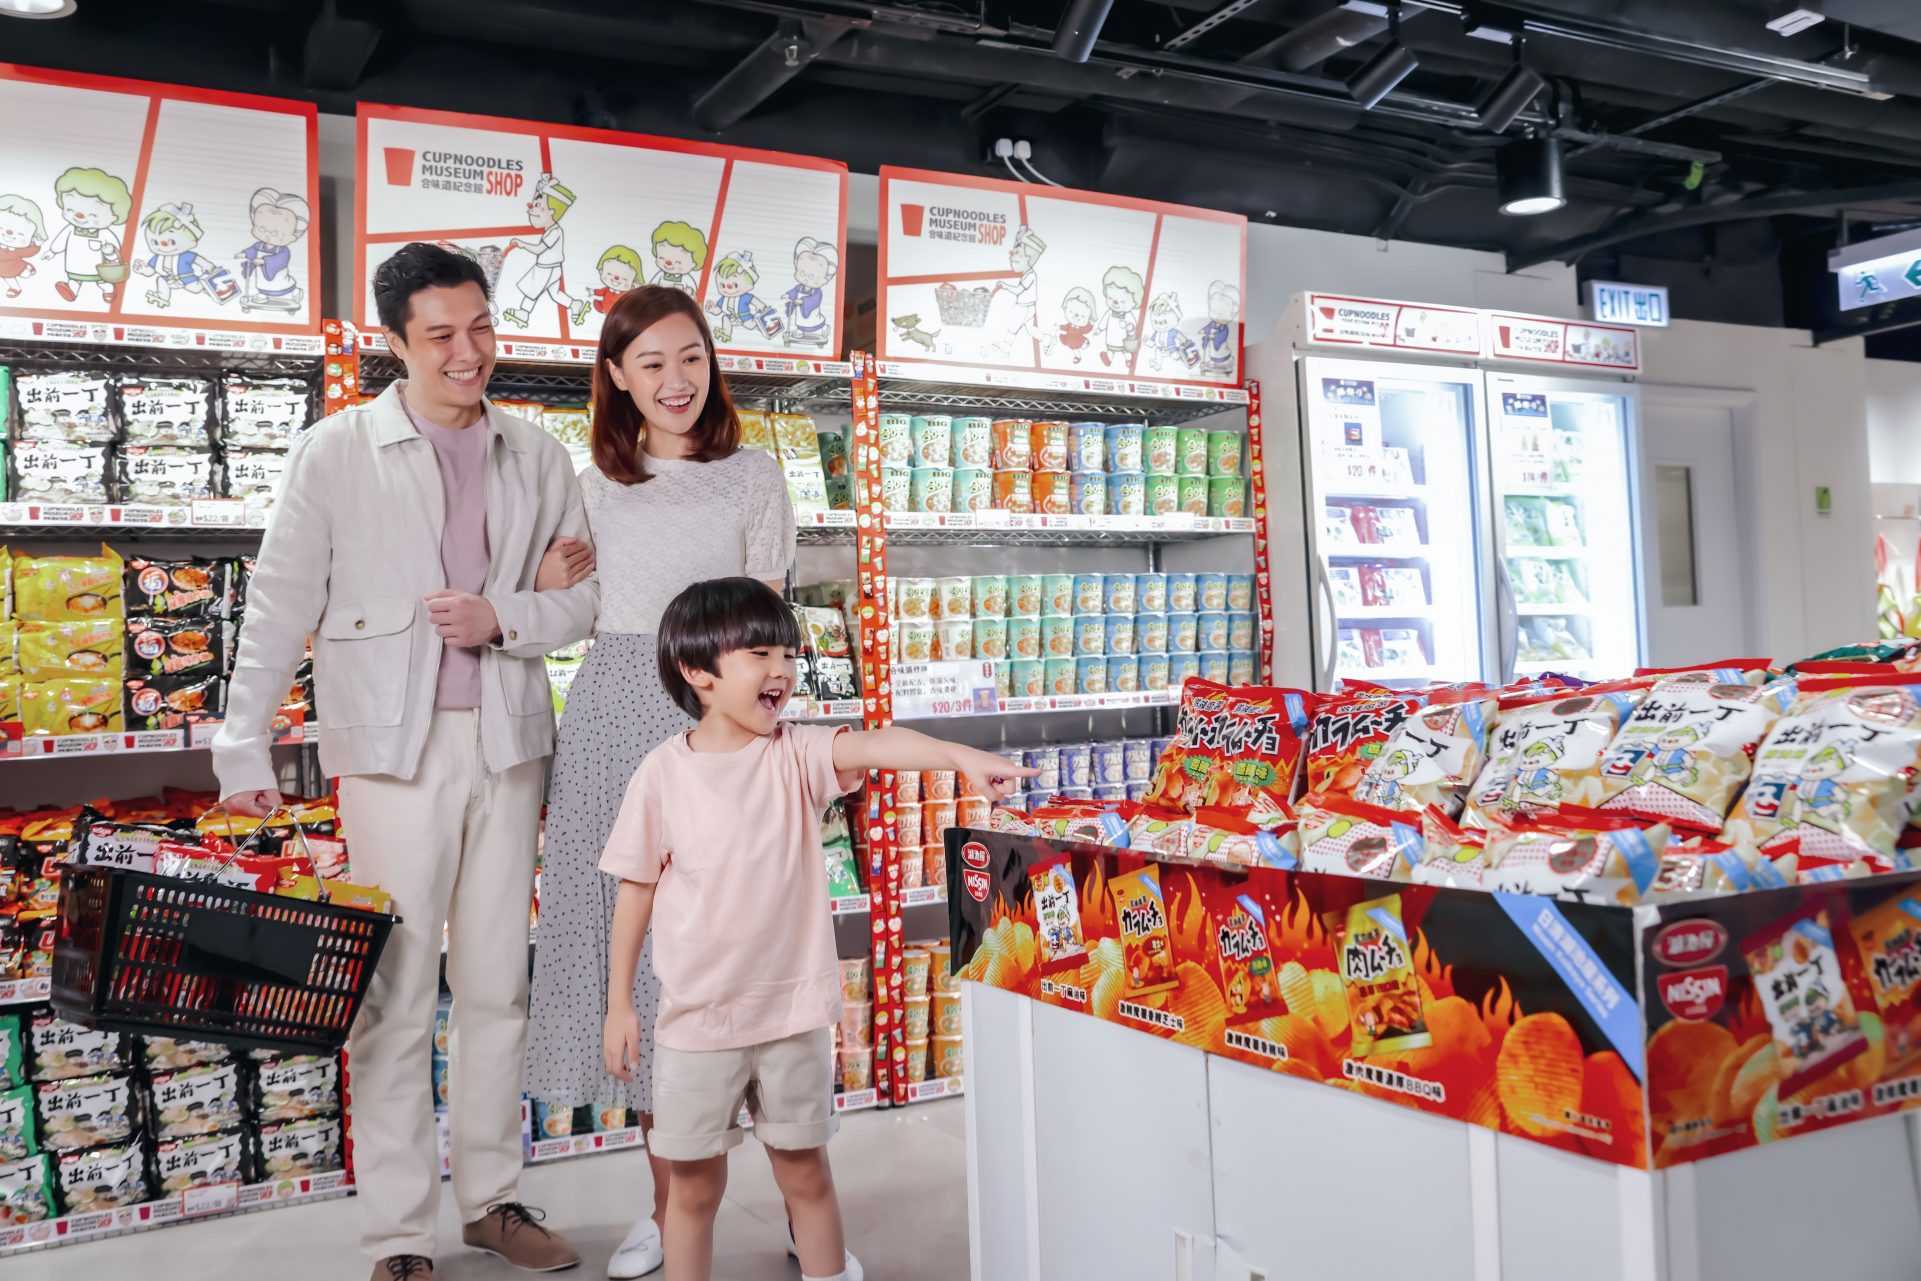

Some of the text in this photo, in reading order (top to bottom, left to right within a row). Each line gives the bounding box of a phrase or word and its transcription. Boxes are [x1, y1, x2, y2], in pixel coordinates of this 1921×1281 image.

[422, 151, 524, 171] CUPNOODLES
[421, 178, 484, 194] 合味道紀念館
[422, 164, 523, 197] MUSEUM SHOP
[929, 206, 1007, 224] CUPNOODLES
[929, 218, 1006, 245] MUSEUM SHOP
[929, 229, 976, 243] 合味道紀念館
[1338, 308, 1390, 321] CUPNOODLES
[1600, 288, 1662, 322] EXIT 出口
[27, 386, 99, 403] 出前一丁
[234, 398, 300, 415] 出前一丁
[131, 399, 201, 415] 出前一丁
[24, 453, 97, 470] 出前一丁
[134, 459, 204, 476] 出前一丁
[235, 464, 283, 480] 出前一
[549, 668, 575, 677] 出前一
[1634, 700, 1746, 724] 出前一丁
[1309, 703, 1409, 752] カラムーチ
[1772, 721, 1896, 746] 出前一丁
[93, 842, 155, 866] 出前一
[968, 873, 988, 891] NISSIN
[1041, 891, 1070, 910] 出前一丁
[1121, 900, 1163, 936] カラムーチョ
[1220, 919, 1264, 958] カラムーチョ
[1346, 933, 1403, 978] 肉ムーチョ
[1667, 976, 1722, 1003] NISSIN
[267, 1063, 331, 1086] 出前一丁
[48, 1086, 122, 1111] 出前一丁
[162, 1073, 230, 1103] 出前一丁
[269, 1127, 334, 1153] 出前一丁
[69, 1154, 136, 1185] 出前一丁
[167, 1143, 234, 1172] 出前一丁
